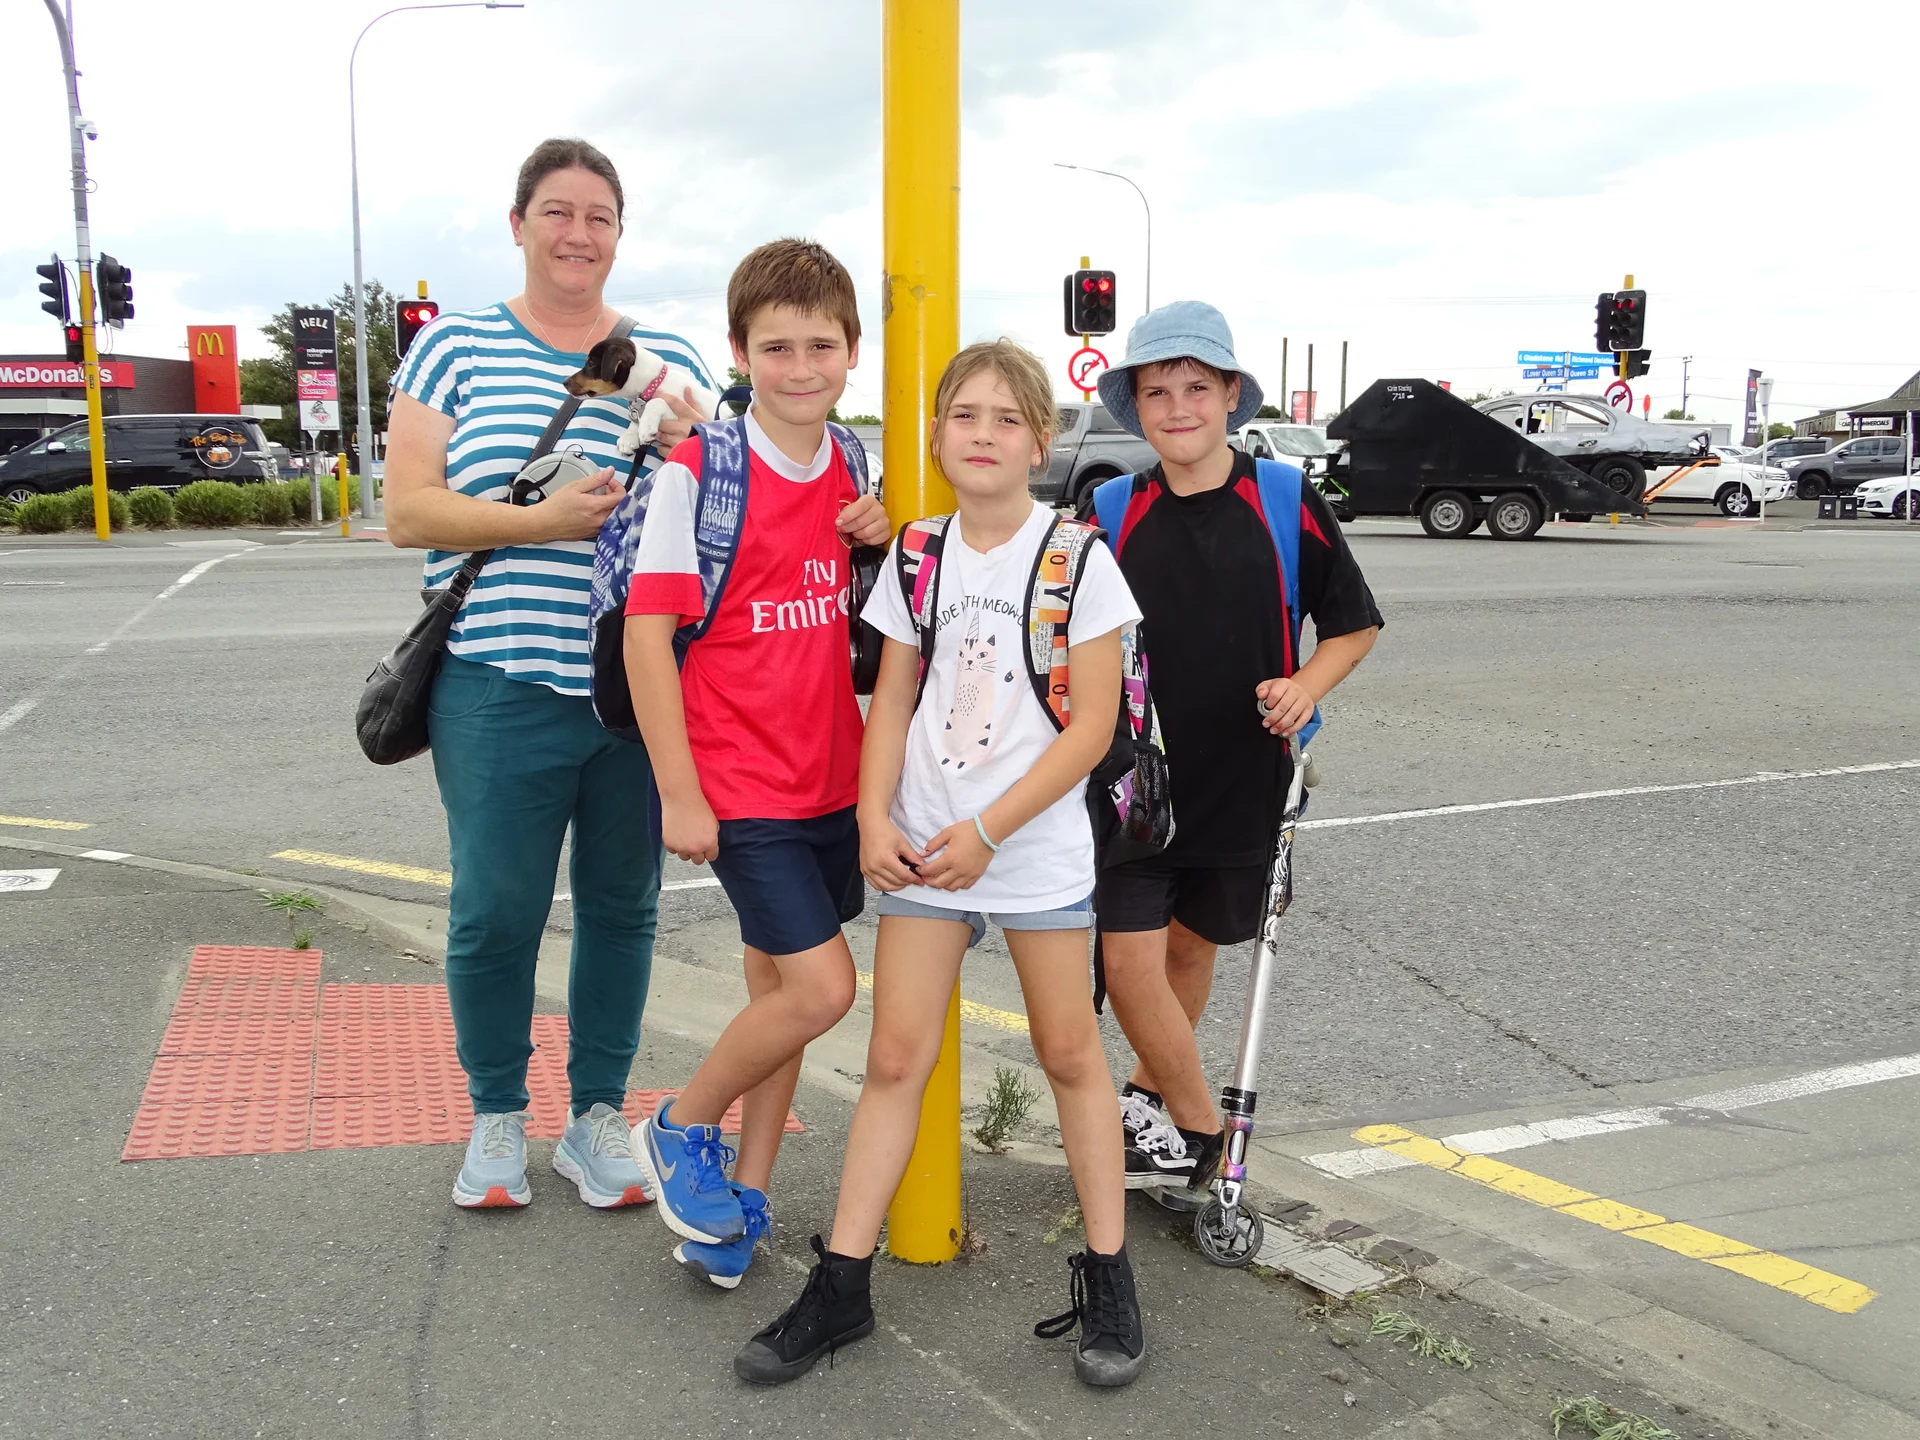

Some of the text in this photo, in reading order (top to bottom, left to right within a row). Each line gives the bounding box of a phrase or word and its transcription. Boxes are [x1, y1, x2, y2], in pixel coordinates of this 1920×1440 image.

[299, 317, 328, 330] HELL
[1523, 354, 1564, 363] Gladstone Rd
[1541, 369, 1557, 377] Queen
[1557, 368, 1563, 376] St
[190, 435, 207, 447] The
[803, 558, 836, 587] Fly
